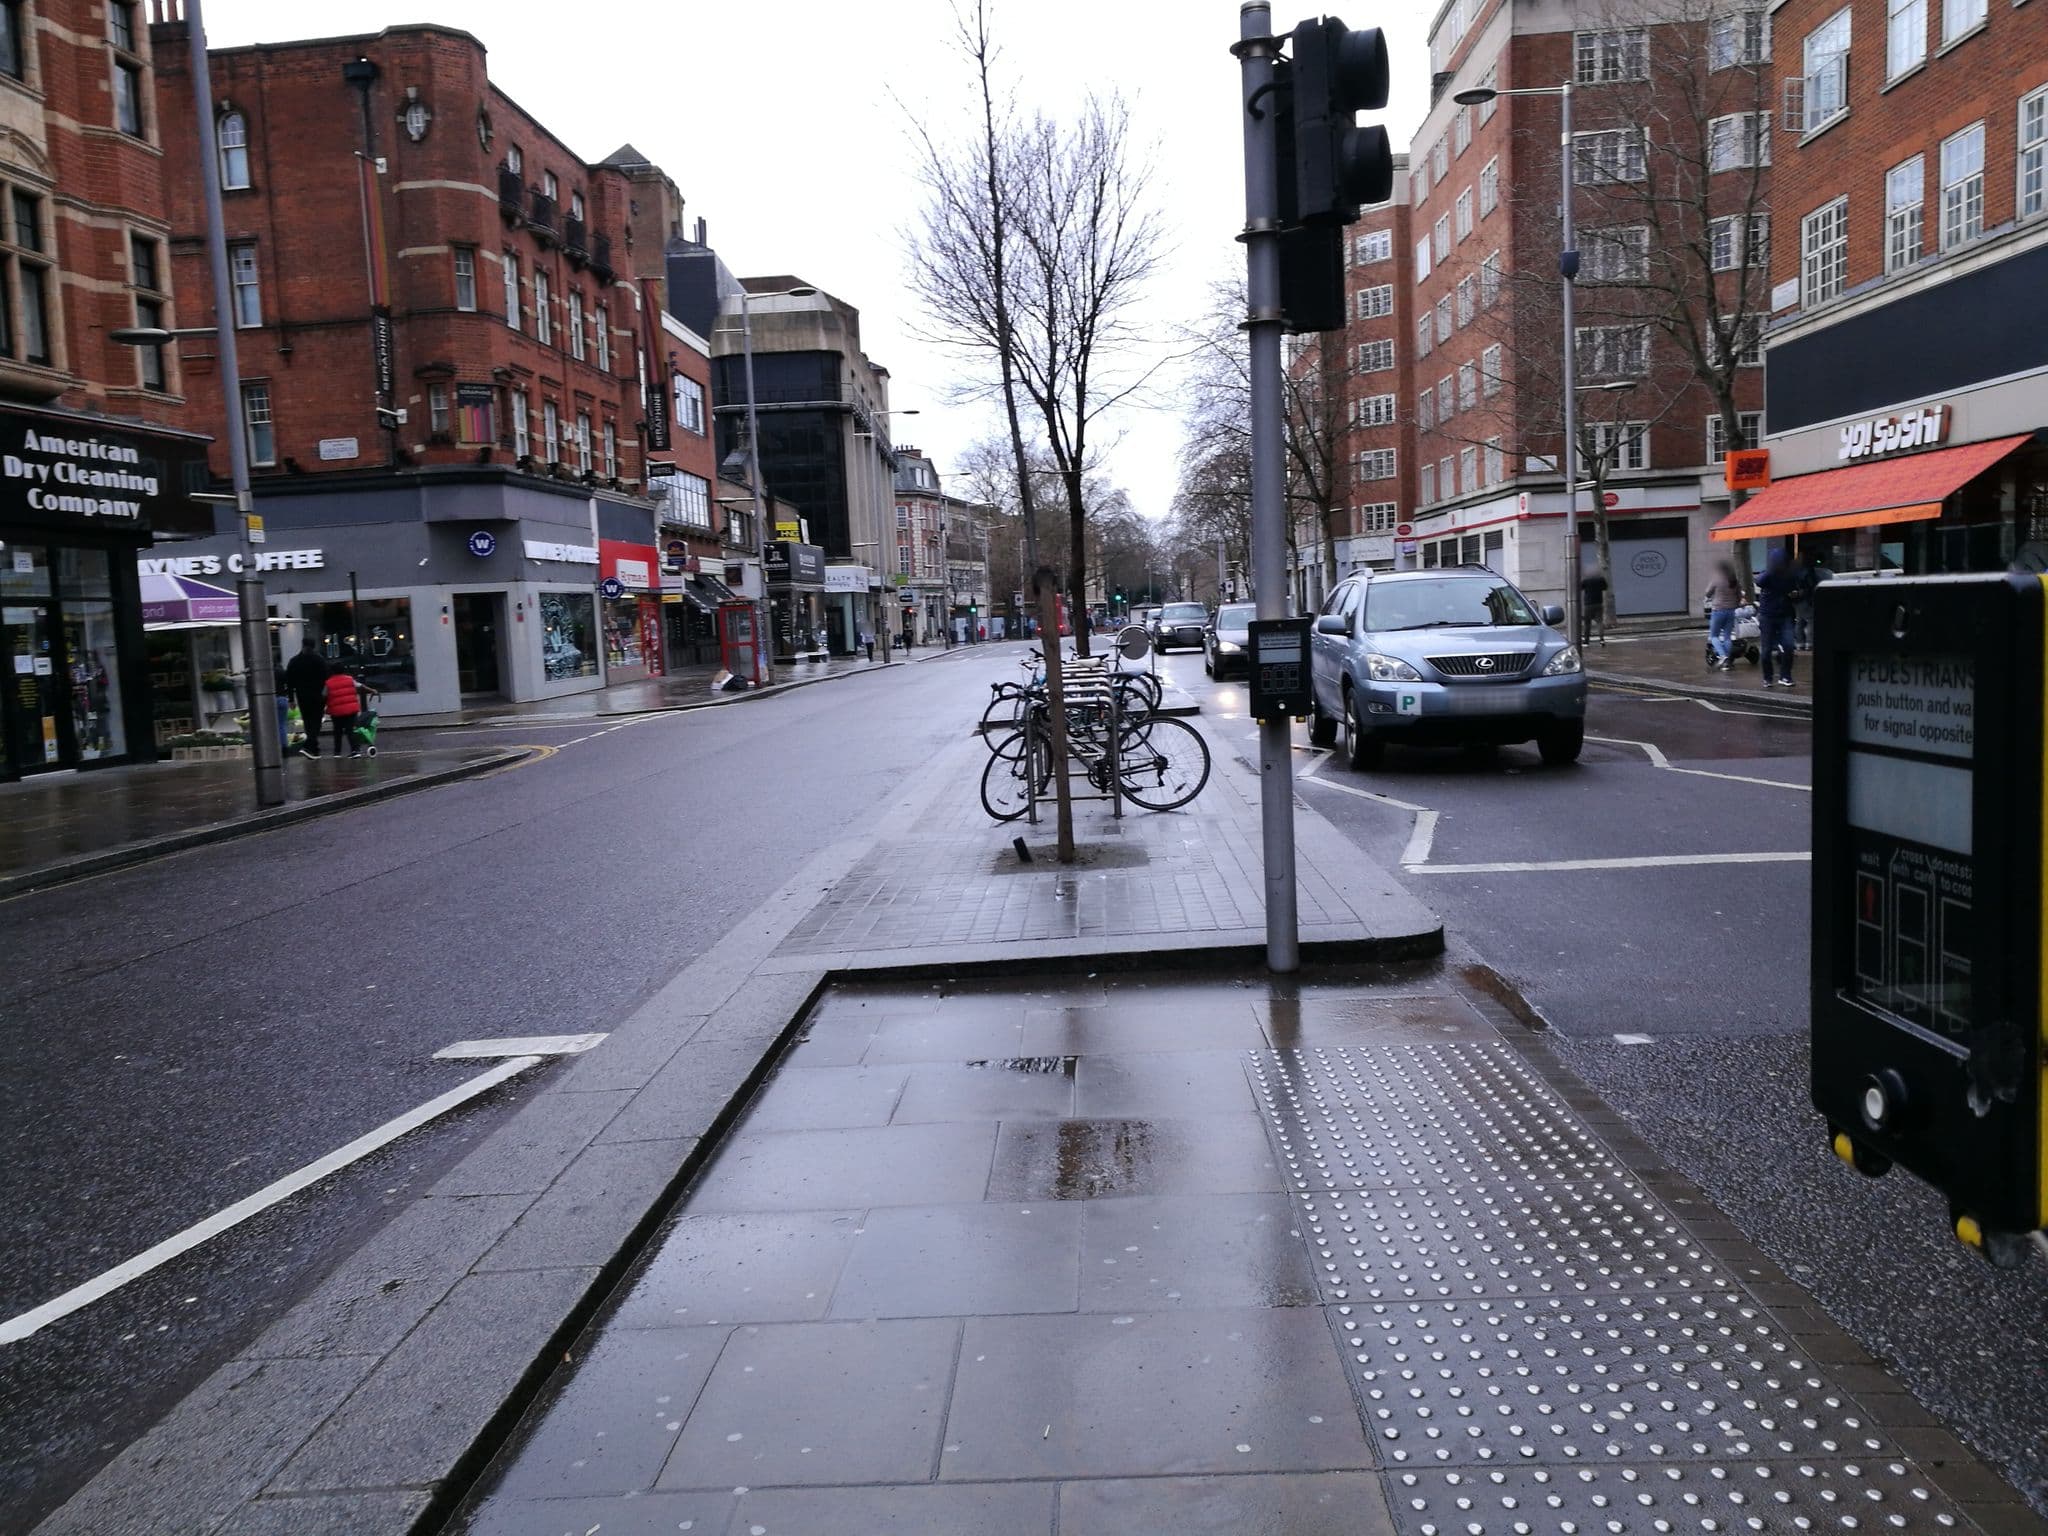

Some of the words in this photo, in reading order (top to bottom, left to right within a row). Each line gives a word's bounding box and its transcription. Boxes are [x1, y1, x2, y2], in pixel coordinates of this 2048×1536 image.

[24, 429, 139, 463] American
[3, 455, 50, 484] Dry
[53, 461, 159, 496] Cleaning
[27, 488, 141, 520] Company
[1857, 660, 1975, 689] PEDESTRIANS
[1402, 696, 1415, 711] P
[1857, 690, 1882, 708] push
[1885, 690, 1924, 712] button
[1927, 696, 1950, 715] and
[1864, 713, 1880, 731] for
[1882, 715, 1917, 739] signal
[1919, 723, 1974, 745] opposite
